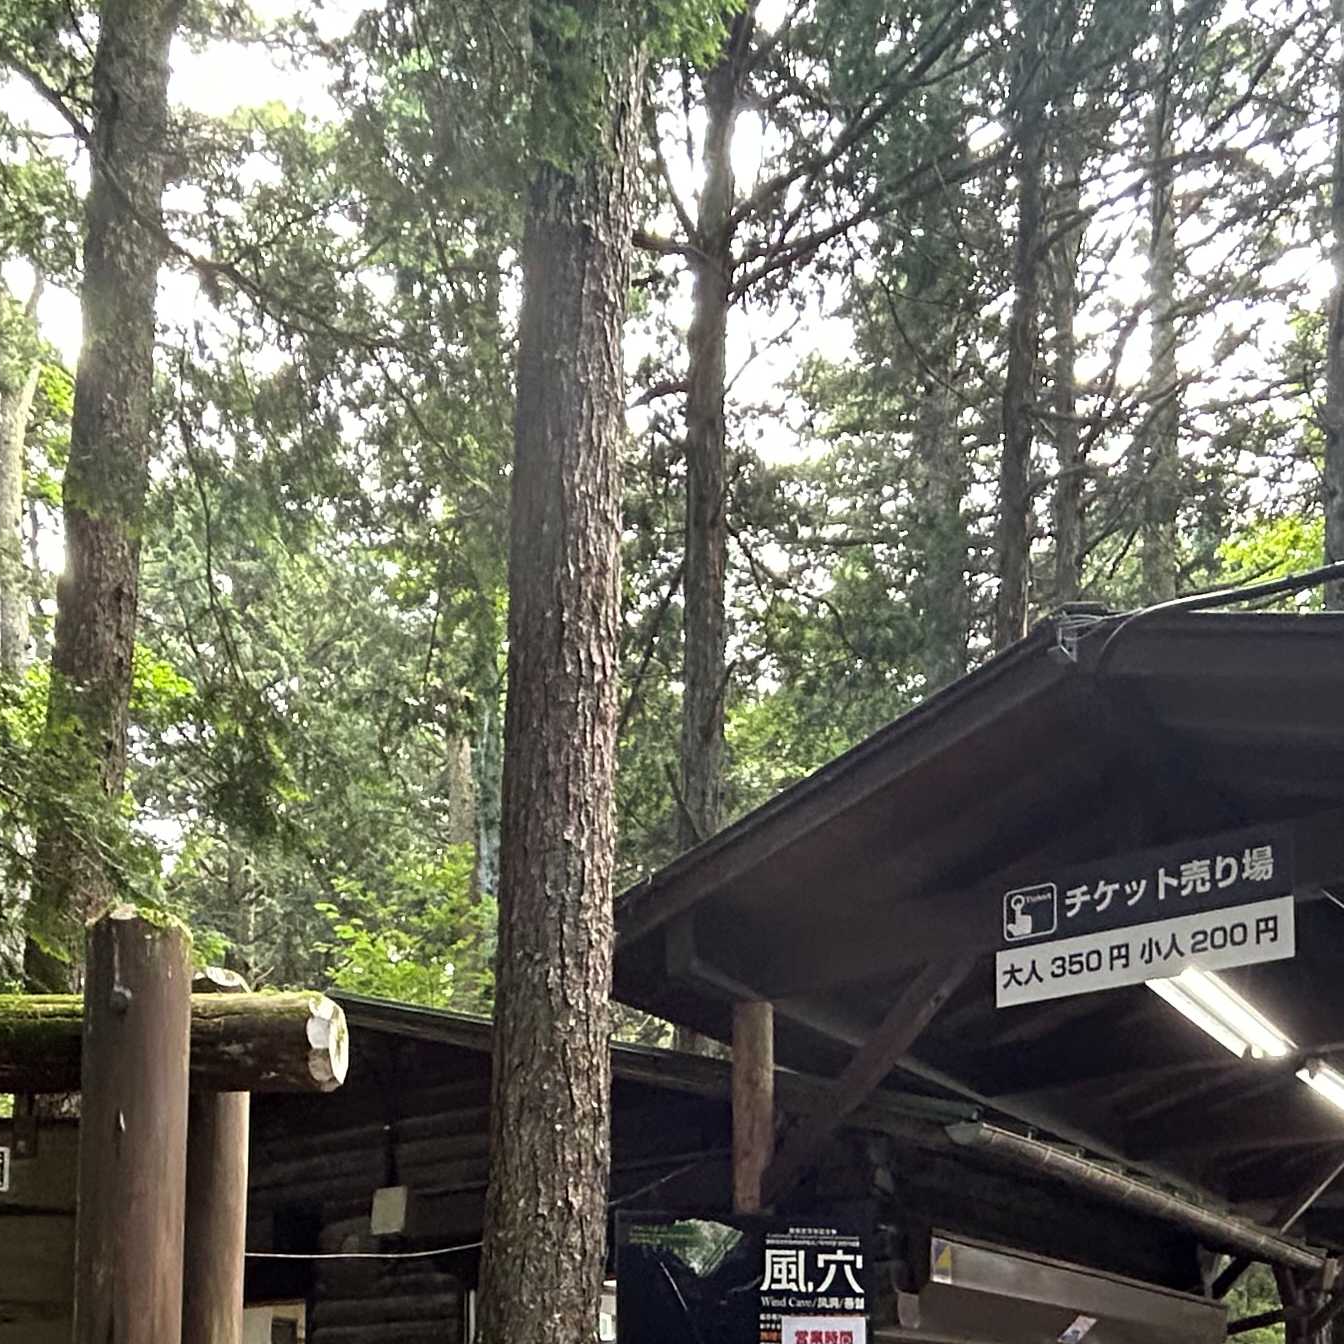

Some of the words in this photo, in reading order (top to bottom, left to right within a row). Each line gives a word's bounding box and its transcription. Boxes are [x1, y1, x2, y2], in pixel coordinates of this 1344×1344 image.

[1064, 845, 1275, 918] チケット売り場
[759, 1248, 865, 1294] 風穴
